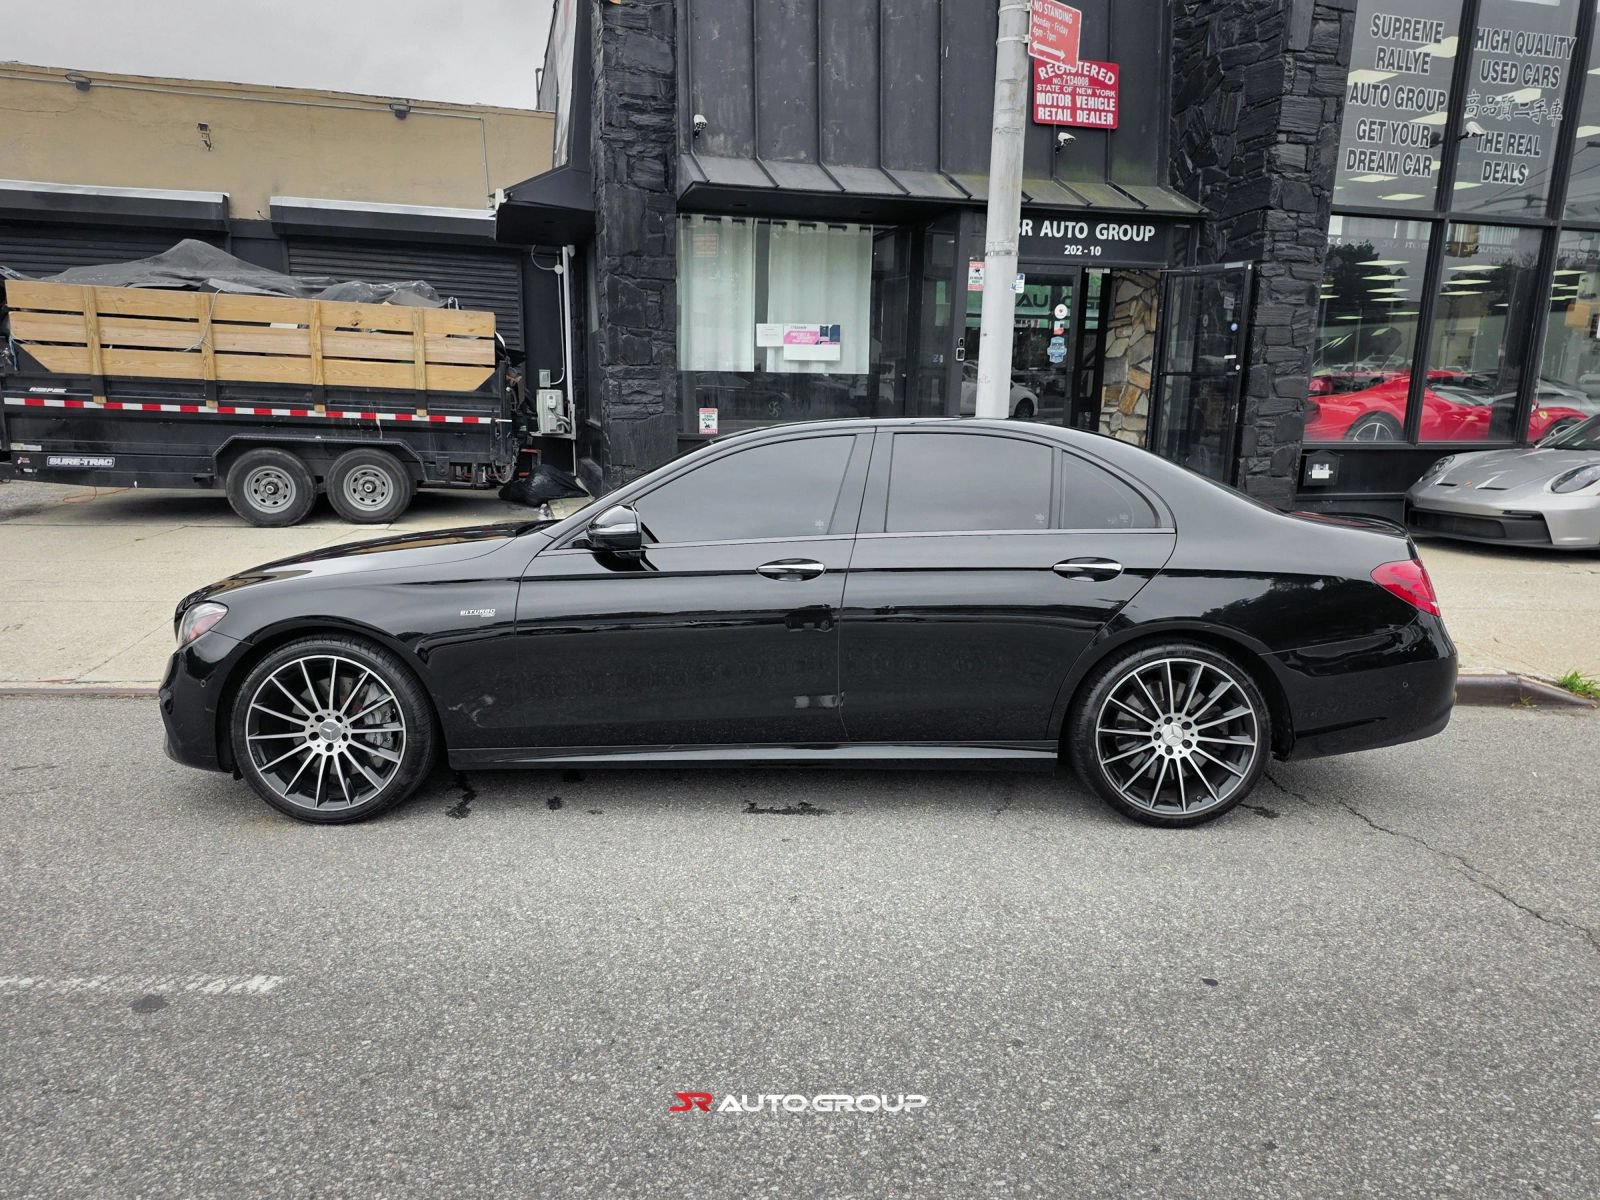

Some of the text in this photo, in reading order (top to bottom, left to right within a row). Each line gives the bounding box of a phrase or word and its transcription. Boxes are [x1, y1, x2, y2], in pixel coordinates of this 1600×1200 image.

[1033, 0, 1073, 24] NO STANDING
[1033, 14, 1051, 29] Monday
[1055, 22, 1068, 37] Friday
[1370, 13, 1445, 44] SUPREME
[1474, 27, 1577, 60] HIGH QUALITY
[1038, 62, 1115, 85] REGTERED
[1375, 46, 1431, 75] RALLYE
[1480, 59, 1560, 89] USED CARS
[1036, 92, 1116, 111] MOTOR VEHICLE
[1037, 84, 1061, 92] STATE
[1076, 87, 1093, 95] NEW
[1095, 89, 1116, 97] YORK
[1348, 82, 1448, 113] AUTO GROUP
[1038, 107, 1114, 125] RETAIL DEALER
[1356, 117, 1431, 148] GET YOUR
[1476, 131, 1542, 157] THE REAL
[1345, 148, 1433, 177] DREAM CAR
[1481, 160, 1528, 186] DEALS
[1018, 219, 1156, 242] R AUTO GROUP
[49, 457, 113, 466] SURE-TRAC
